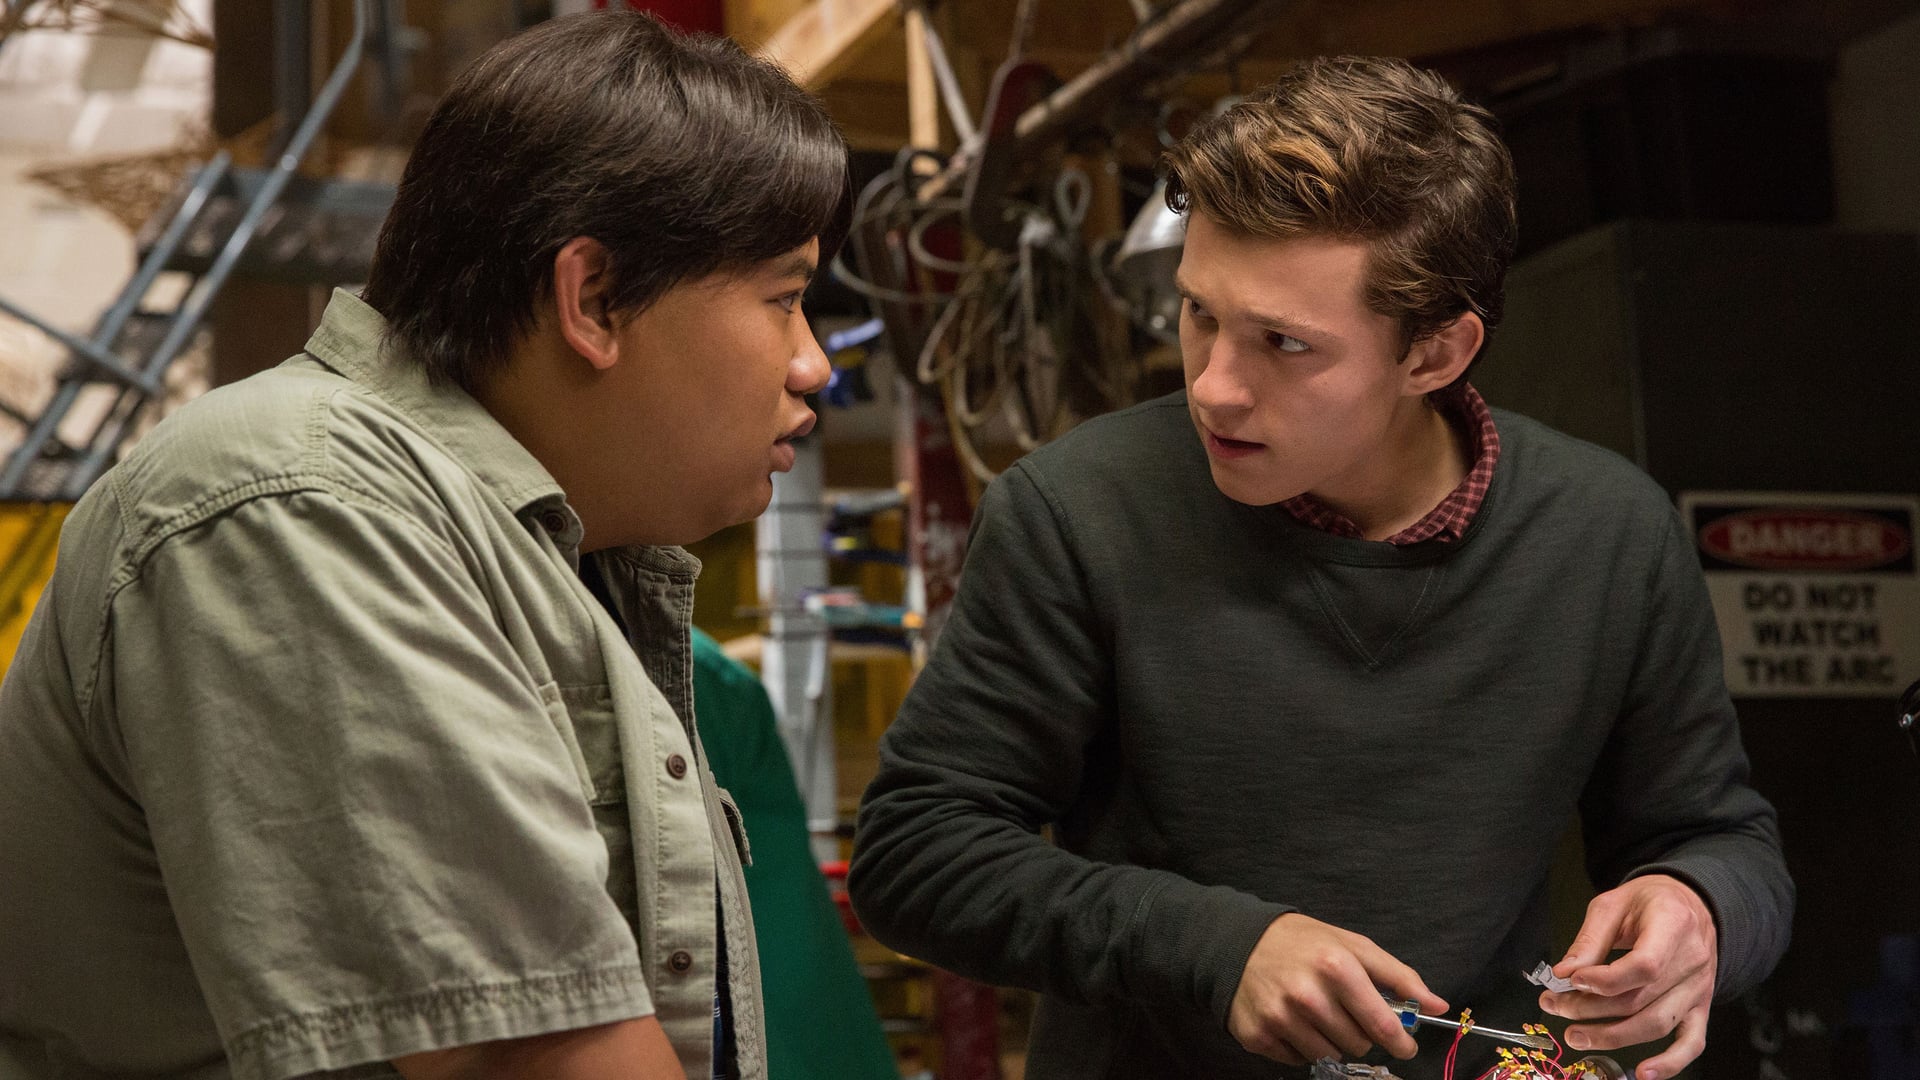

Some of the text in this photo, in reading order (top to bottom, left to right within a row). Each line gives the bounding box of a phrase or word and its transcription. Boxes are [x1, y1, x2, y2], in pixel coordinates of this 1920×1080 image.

[1729, 523, 1881, 556] DANGER
[1744, 581, 1875, 611] DO NOT
[1755, 620, 1880, 646] WATCH
[1742, 655, 1896, 685] THE ARC
